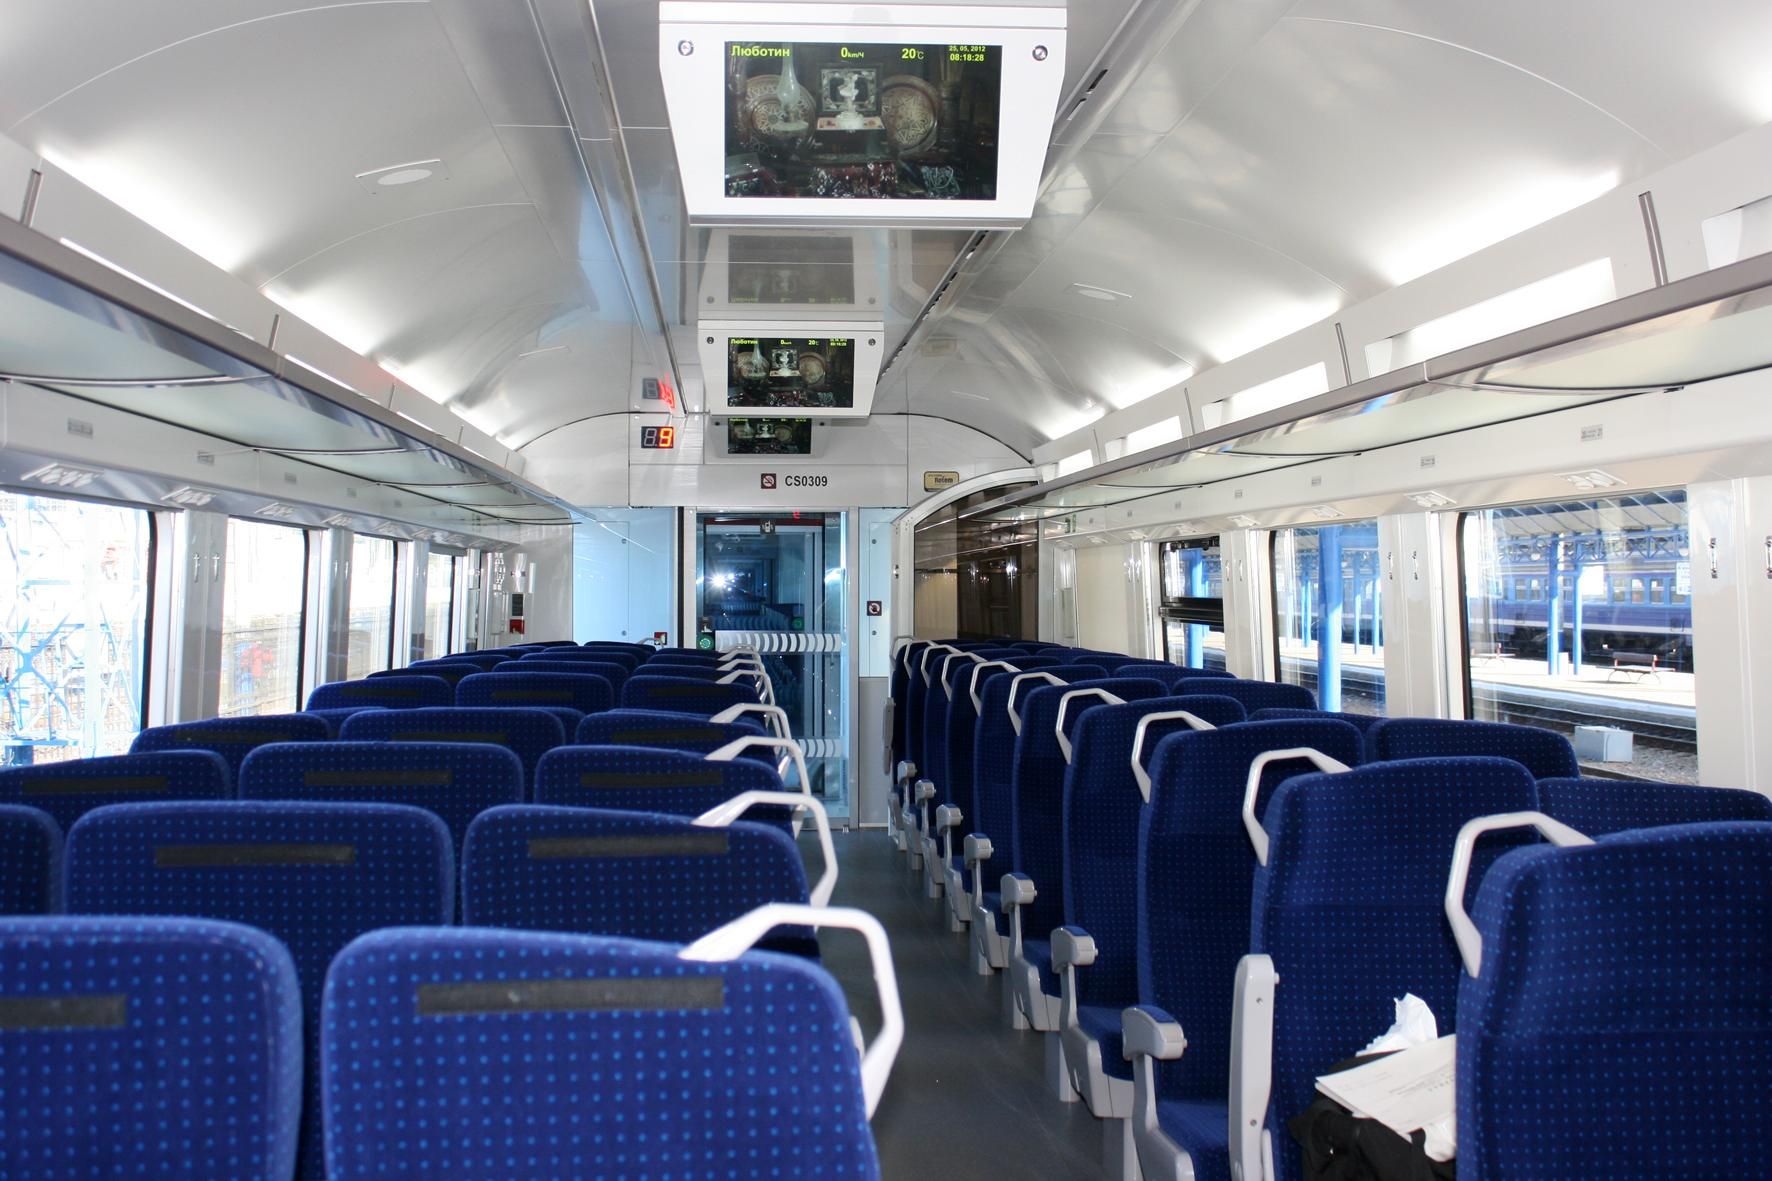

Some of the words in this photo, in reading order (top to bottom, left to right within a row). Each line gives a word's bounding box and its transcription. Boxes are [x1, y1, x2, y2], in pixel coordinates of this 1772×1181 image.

[731, 45, 790, 57] Люботин
[950, 53, 984, 62] 08:18:28
[784, 475, 828, 487] CS0309
